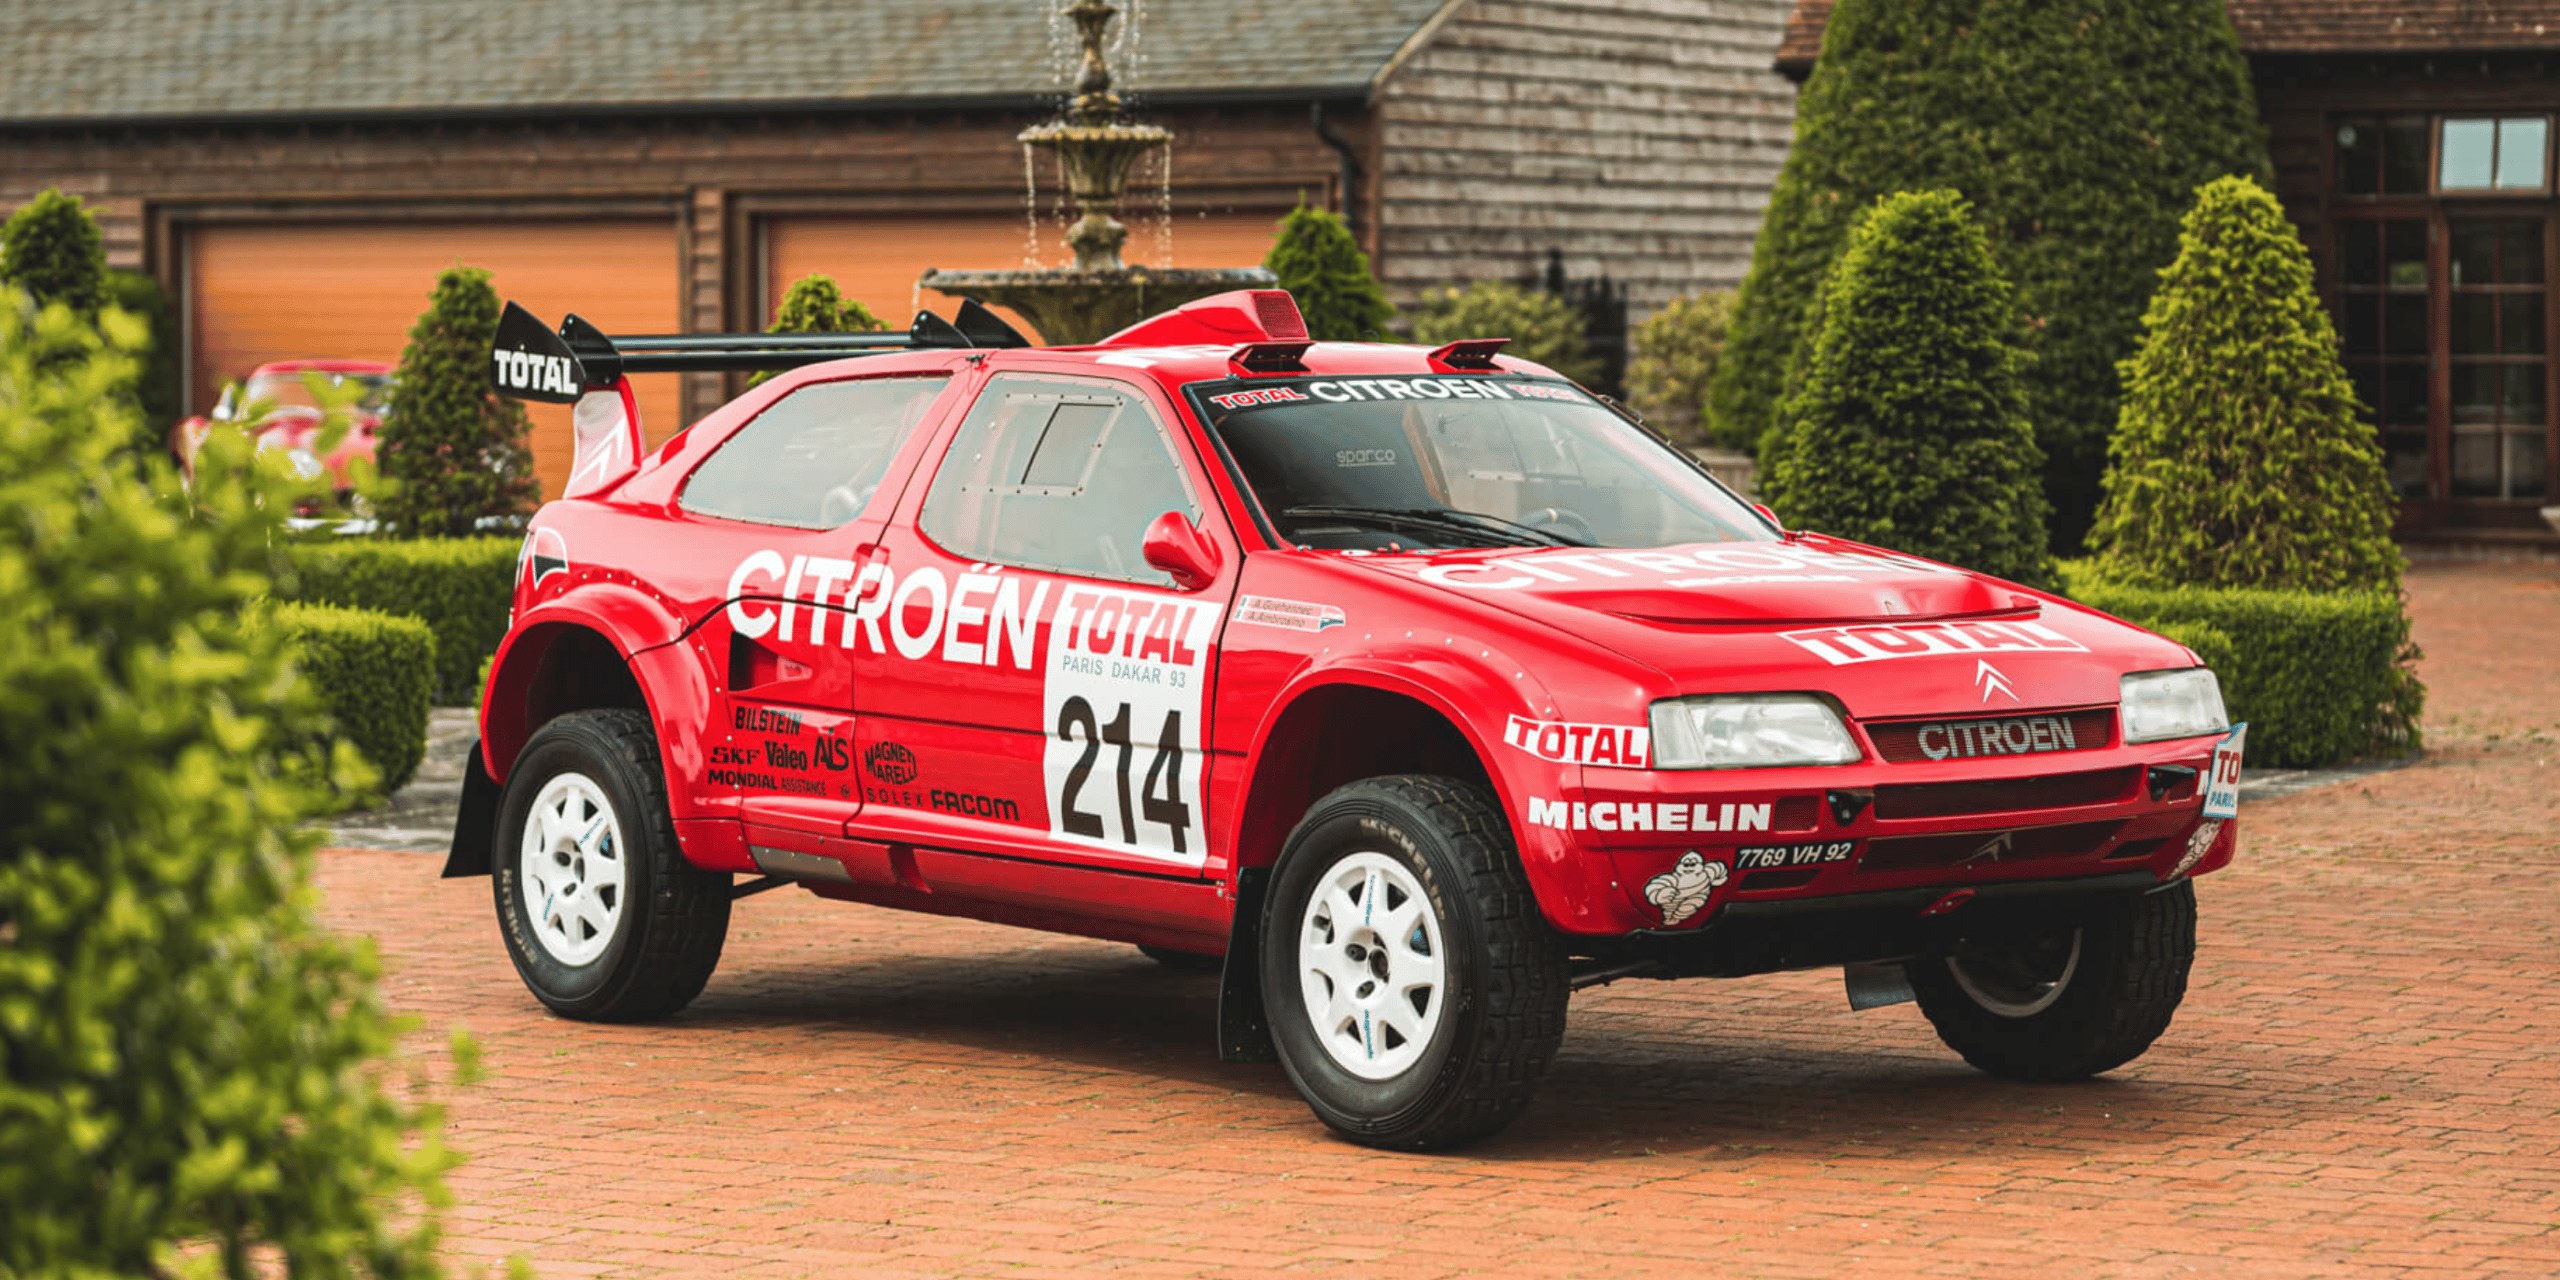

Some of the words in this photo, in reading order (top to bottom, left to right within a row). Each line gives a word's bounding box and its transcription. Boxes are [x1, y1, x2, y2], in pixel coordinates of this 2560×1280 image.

[494, 348, 579, 396] TOTAL
[1208, 386, 1310, 410] TOTAL
[1308, 378, 1514, 402] CITROEN
[1336, 449, 1397, 465] sparco
[727, 548, 1051, 671] CITROËN
[1067, 591, 1198, 667] TOTAL
[1783, 622, 2086, 661] TOTAL
[1062, 654, 1104, 676] PARIS
[1110, 660, 1162, 685] DAKAR
[1169, 670, 1186, 689] 93
[735, 705, 802, 736] BILSTEIN
[710, 746, 760, 765] SKF
[764, 739, 808, 772] Valeo
[1511, 716, 1648, 766] TOTAL
[1918, 716, 2077, 762] CITROEN
[707, 769, 778, 791] MONDIAL
[780, 776, 827, 797] ASSISTANCE
[1057, 694, 1191, 854] 214
[865, 787, 924, 808] SOLEX
[930, 789, 1021, 822] FACOM
[1527, 795, 1772, 832] MICHELIN
[1736, 846, 1786, 870] 7769
[1791, 844, 1824, 866] VH
[1827, 841, 1852, 862] 92
